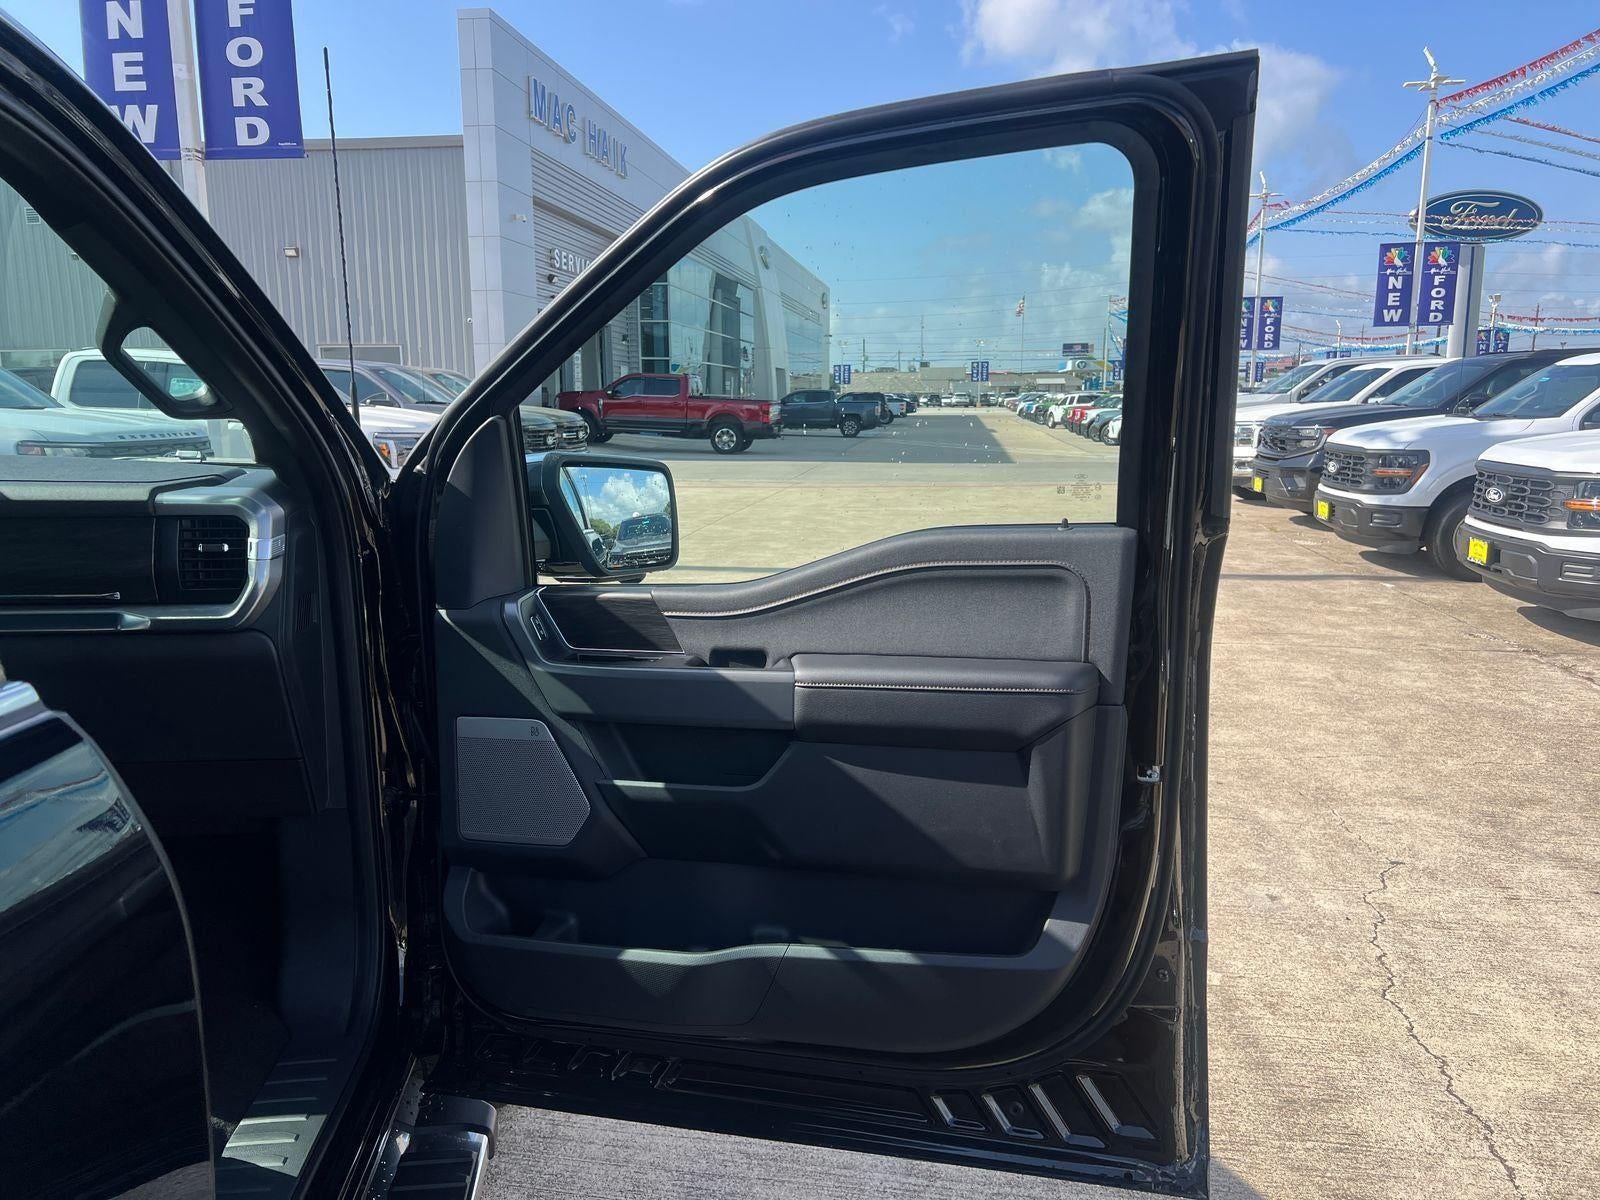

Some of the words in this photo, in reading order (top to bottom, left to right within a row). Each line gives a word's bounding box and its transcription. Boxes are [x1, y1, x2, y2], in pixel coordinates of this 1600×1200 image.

[105, 0, 158, 144] NEW
[225, 0, 270, 146] FORD
[528, 76, 577, 144] MAC
[584, 119, 627, 178] HAIK
[1264, 318, 1275, 348] FORD
[1383, 276, 1403, 322] NEW
[1428, 275, 1446, 322] FORD
